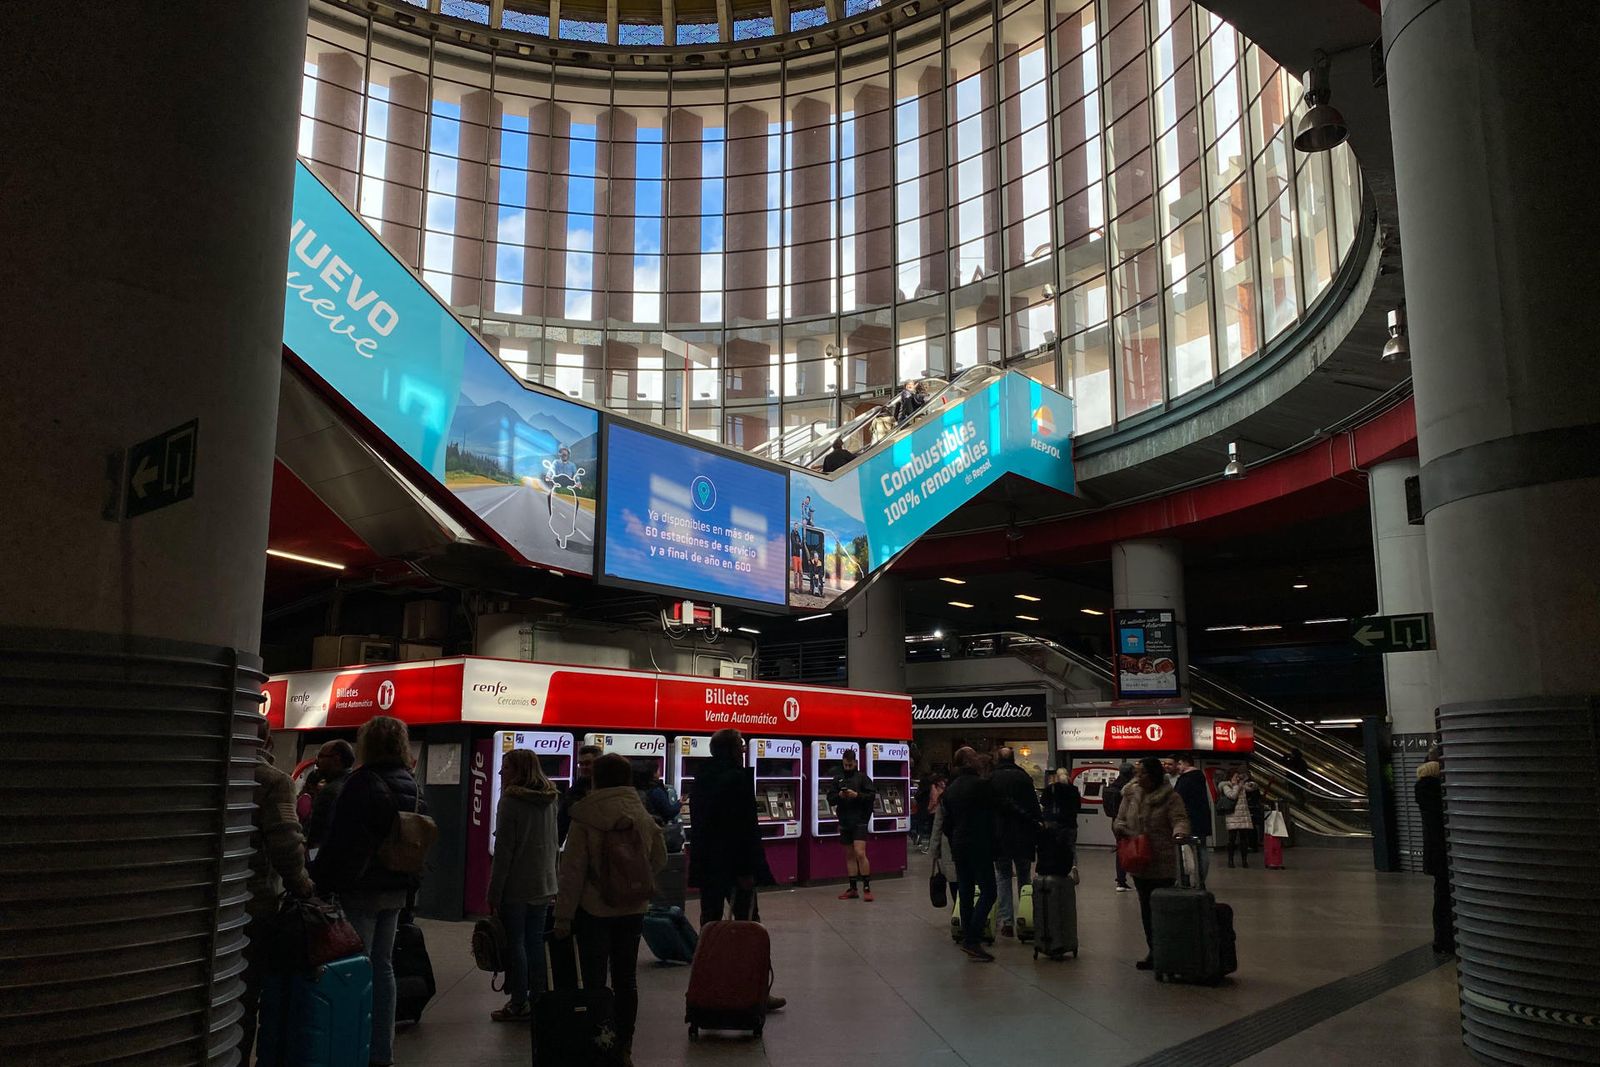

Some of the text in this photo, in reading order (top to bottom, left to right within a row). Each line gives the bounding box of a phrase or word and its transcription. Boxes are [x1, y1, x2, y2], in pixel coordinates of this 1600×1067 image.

[287, 271, 378, 359] ueve
[1031, 438, 1061, 460] REPSOL
[881, 421, 977, 497] Combustibles
[971, 458, 992, 479] Repsol
[884, 440, 988, 526] 100% renovables
[648, 509, 755, 542] Ya disponibles en más de
[645, 526, 757, 558] 60 estaciones de servicio
[650, 545, 751, 573] y a final de año en 600
[290, 691, 310, 704] renfe
[336, 688, 359, 698] Billetes
[473, 681, 508, 697] renfe
[705, 688, 750, 706] Billetes
[705, 710, 778, 725] Venta Automática
[961, 703, 979, 719] de
[982, 701, 1032, 719] Galicia
[1061, 728, 1082, 737] renfe
[1111, 725, 1141, 735] Billetes
[534, 735, 571, 753] renfe
[634, 738, 665, 754] renfe
[776, 742, 801, 757] renfe
[888, 746, 908, 759] renfe
[471, 751, 488, 826] renfe
